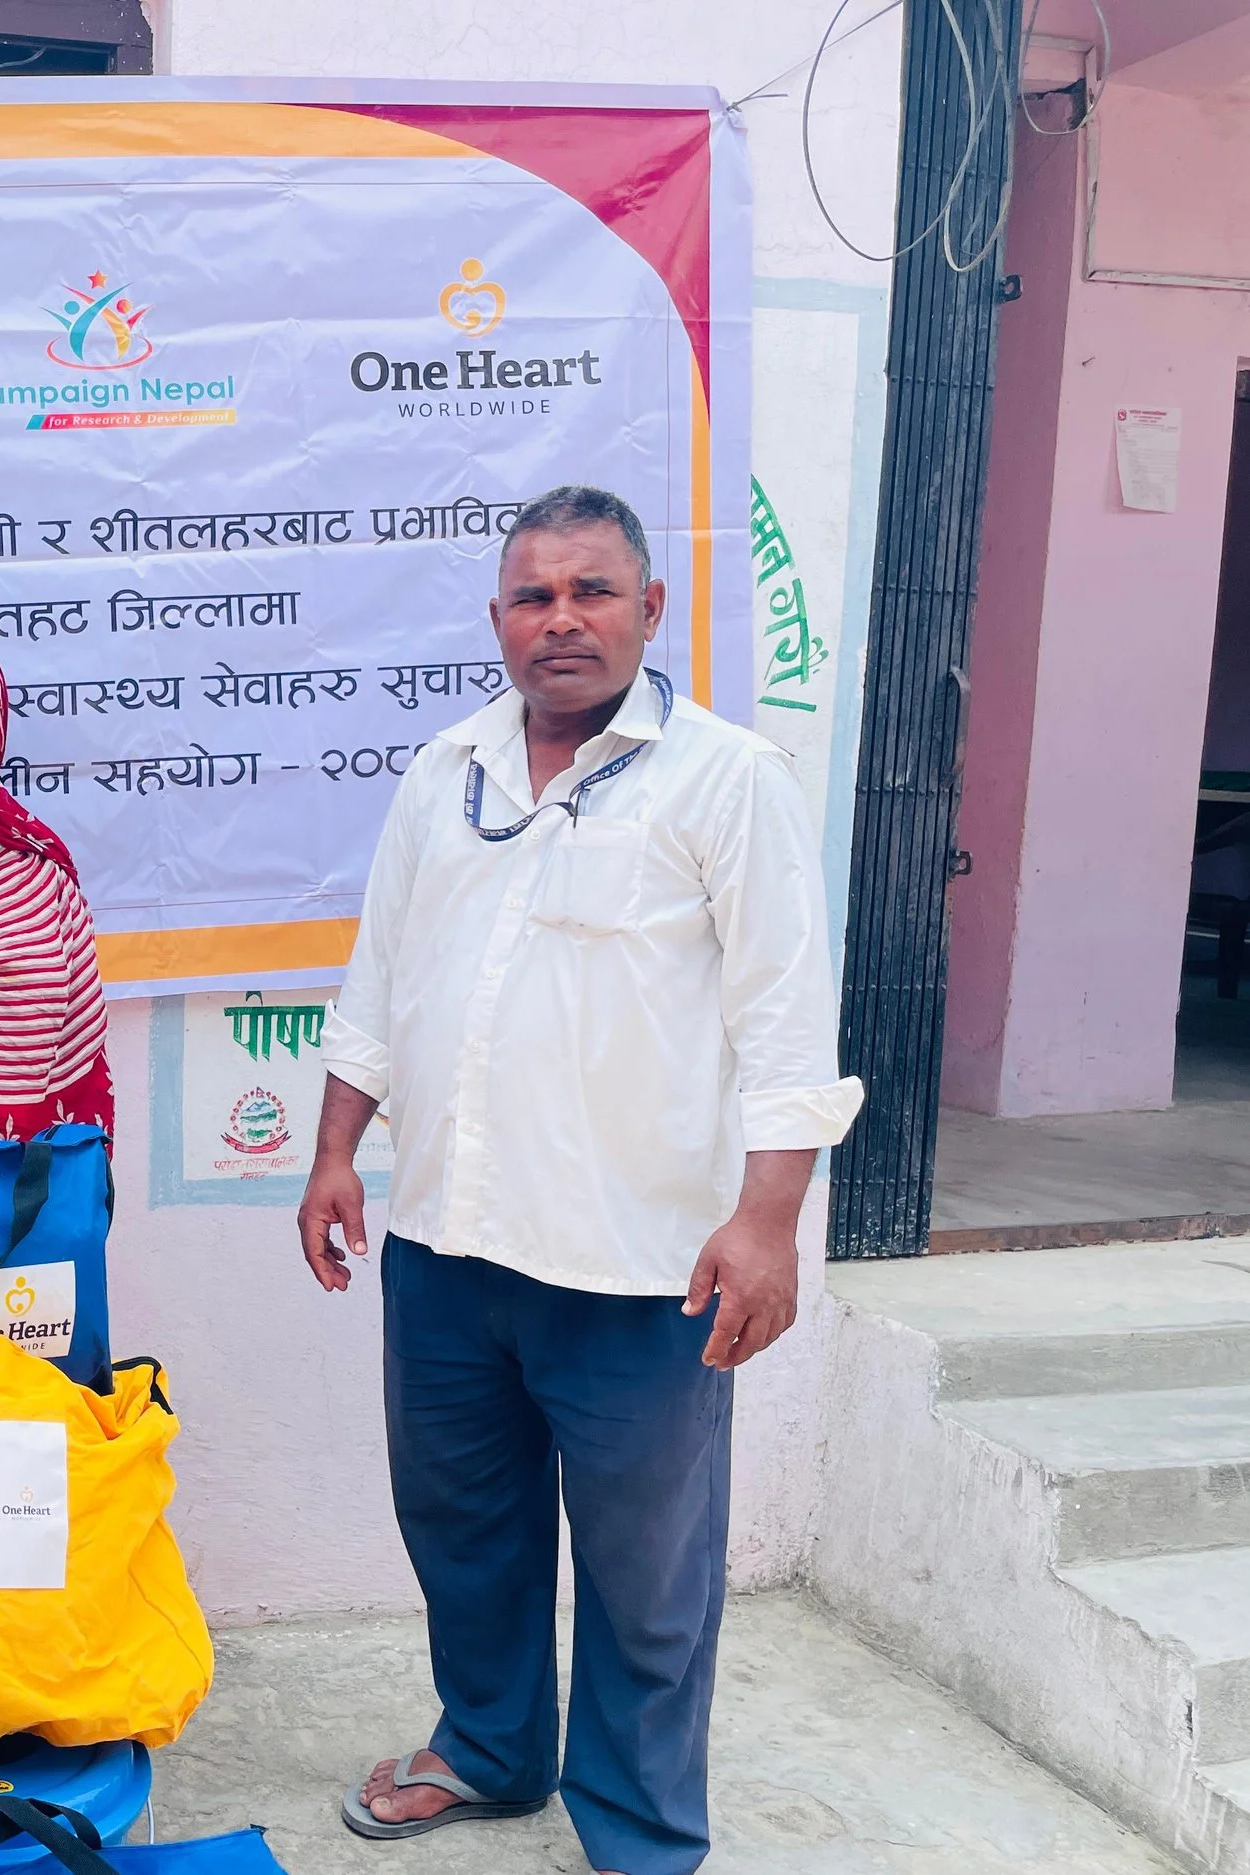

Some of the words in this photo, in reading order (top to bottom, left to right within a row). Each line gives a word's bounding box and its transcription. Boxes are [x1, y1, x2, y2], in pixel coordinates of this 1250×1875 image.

[350, 351, 448, 392] One
[456, 350, 601, 390] Heart
[141, 375, 234, 405] Nepal
[49, 416, 68, 429] for
[73, 414, 131, 426] Research
[133, 414, 143, 424] &
[147, 412, 230, 426] Development
[398, 399, 551, 418] WORLDWIDE
[38, 519, 72, 555] र
[90, 508, 354, 554] शीतलहरबाट
[108, 589, 301, 632] जिल्लामा
[6, 676, 185, 718] स्वास्थ्य
[201, 661, 361, 710] सेवाहरु
[92, 742, 261, 796] सहयोग
[321, 743, 429, 781] २०८
[583, 770, 610, 786] Office
[9, 1318, 71, 1341] Heart
[2, 1505, 22, 1515] One
[23, 1505, 51, 1515] Heart
